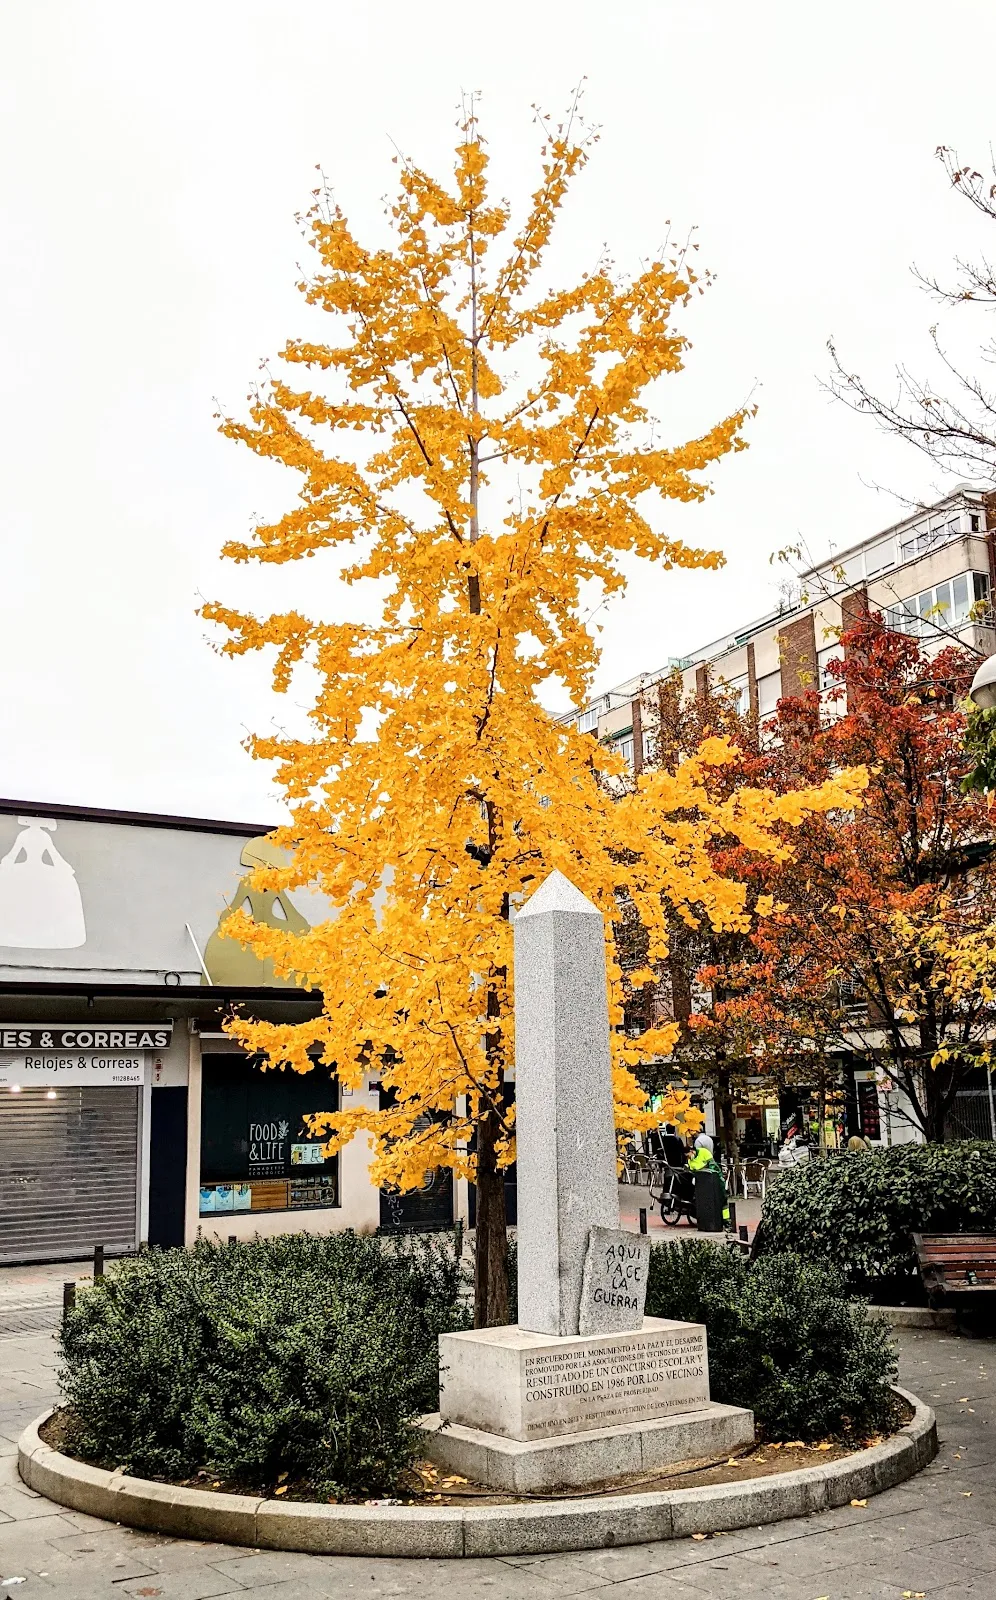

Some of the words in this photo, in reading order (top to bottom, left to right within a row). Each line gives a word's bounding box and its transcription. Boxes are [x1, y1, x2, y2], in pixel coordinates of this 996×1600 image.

[0, 1031, 31, 1048] ES
[39, 1031, 54, 1048] &
[61, 1032, 168, 1048] CORREAS
[25, 1056, 73, 1072] Relojes
[77, 1056, 87, 1069] &
[91, 1056, 139, 1069] Correas
[249, 1123, 278, 1141] FOOD
[605, 1244, 641, 1262] AQUI
[606, 1259, 641, 1281] YACE
[612, 1276, 628, 1291] LA
[593, 1288, 638, 1310] GUERRA
[525, 1358, 535, 1366] EN
[536, 1353, 573, 1365] RECUERDO
[573, 1351, 586, 1359] DEL
[587, 1345, 631, 1357] MONUMENTO
[637, 1343, 646, 1351] LA
[647, 1341, 660, 1349] PAZ
[674, 1335, 703, 1345] DESARME
[525, 1364, 564, 1376] PROMOVIDO
[565, 1361, 578, 1370] POR
[578, 1360, 591, 1368] LAS
[592, 1353, 636, 1367] ASOCIACIONES
[636, 1352, 645, 1360] DE
[646, 1349, 671, 1358] VECINOS
[680, 1344, 704, 1354] MADRID
[526, 1371, 580, 1388] RESULTADO
[582, 1369, 595, 1380] DE
[596, 1366, 609, 1377] UN
[610, 1360, 657, 1375] CONCURSO
[658, 1356, 696, 1368] ESCOLAR
[697, 1354, 703, 1363] Y
[526, 1383, 589, 1402] CONSTRUIDO
[591, 1380, 604, 1391] EN
[607, 1377, 625, 1389] 1986
[627, 1374, 645, 1387] POR
[646, 1371, 664, 1383] LOS
[665, 1366, 704, 1380] VECINOS
[588, 1395, 596, 1403] LA
[623, 1386, 659, 1397] PROSPERIDAD
